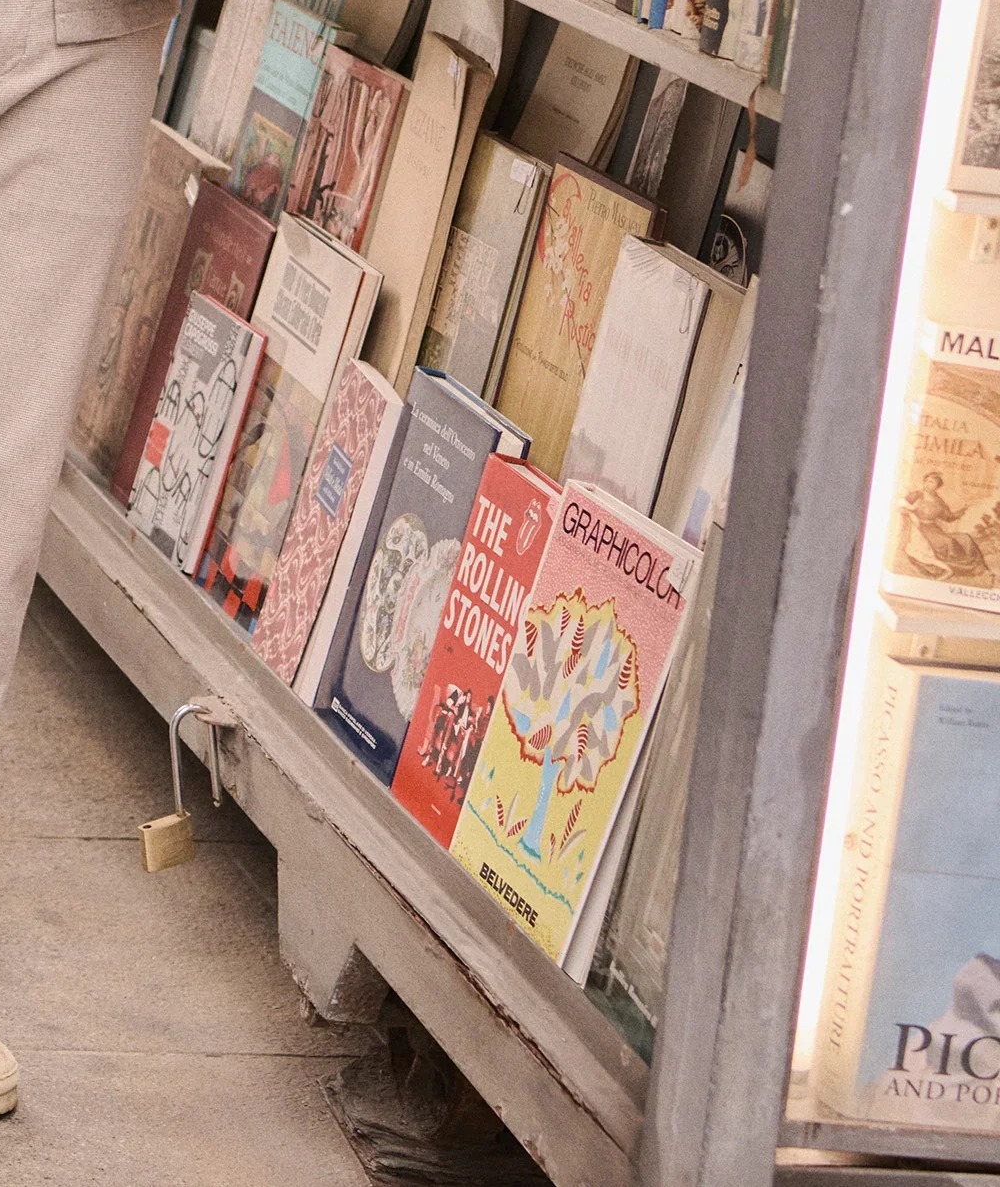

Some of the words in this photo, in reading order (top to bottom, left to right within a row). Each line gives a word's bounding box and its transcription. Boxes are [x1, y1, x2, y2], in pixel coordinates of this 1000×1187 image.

[940, 331, 1000, 361] MAL
[411, 401, 419, 417] La
[419, 408, 441, 434] ceramica
[472, 495, 512, 557] THE
[444, 589, 513, 675] STONES
[869, 684, 898, 794] PICASSO
[858, 798, 879, 860] AND
[479, 861, 539, 928] BELVEDERE
[829, 867, 870, 1055] PORTRAITURE
[887, 1022, 1000, 1081] PIC
[883, 1077, 946, 1100] AND
